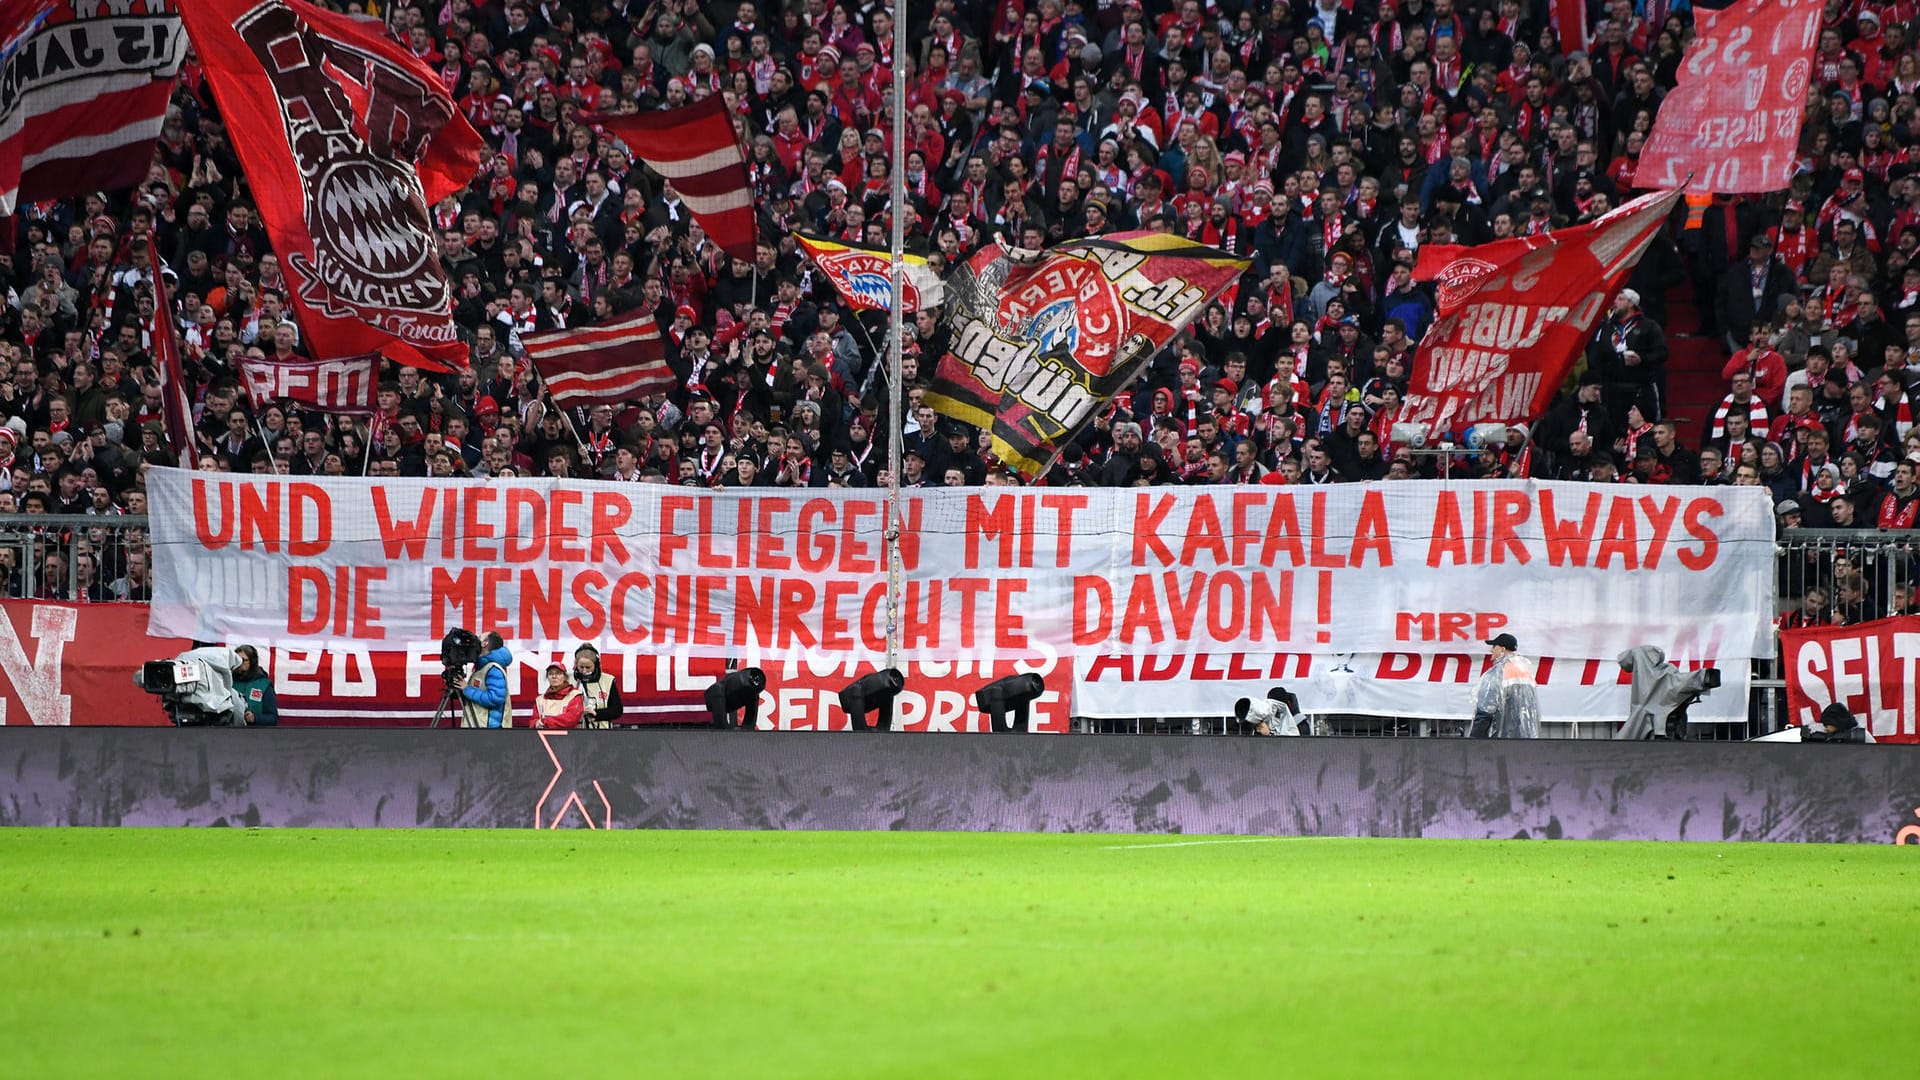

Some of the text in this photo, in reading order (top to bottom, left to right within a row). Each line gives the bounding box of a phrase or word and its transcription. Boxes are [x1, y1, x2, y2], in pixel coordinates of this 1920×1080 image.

[192, 480, 1725, 573] UND WIEDER FLIEGEN MIT KAFALA AIRWAYS
[287, 565, 387, 639] DIE
[431, 567, 1028, 651] MENSCHENRECHTE
[1395, 612, 1508, 641] MRP
